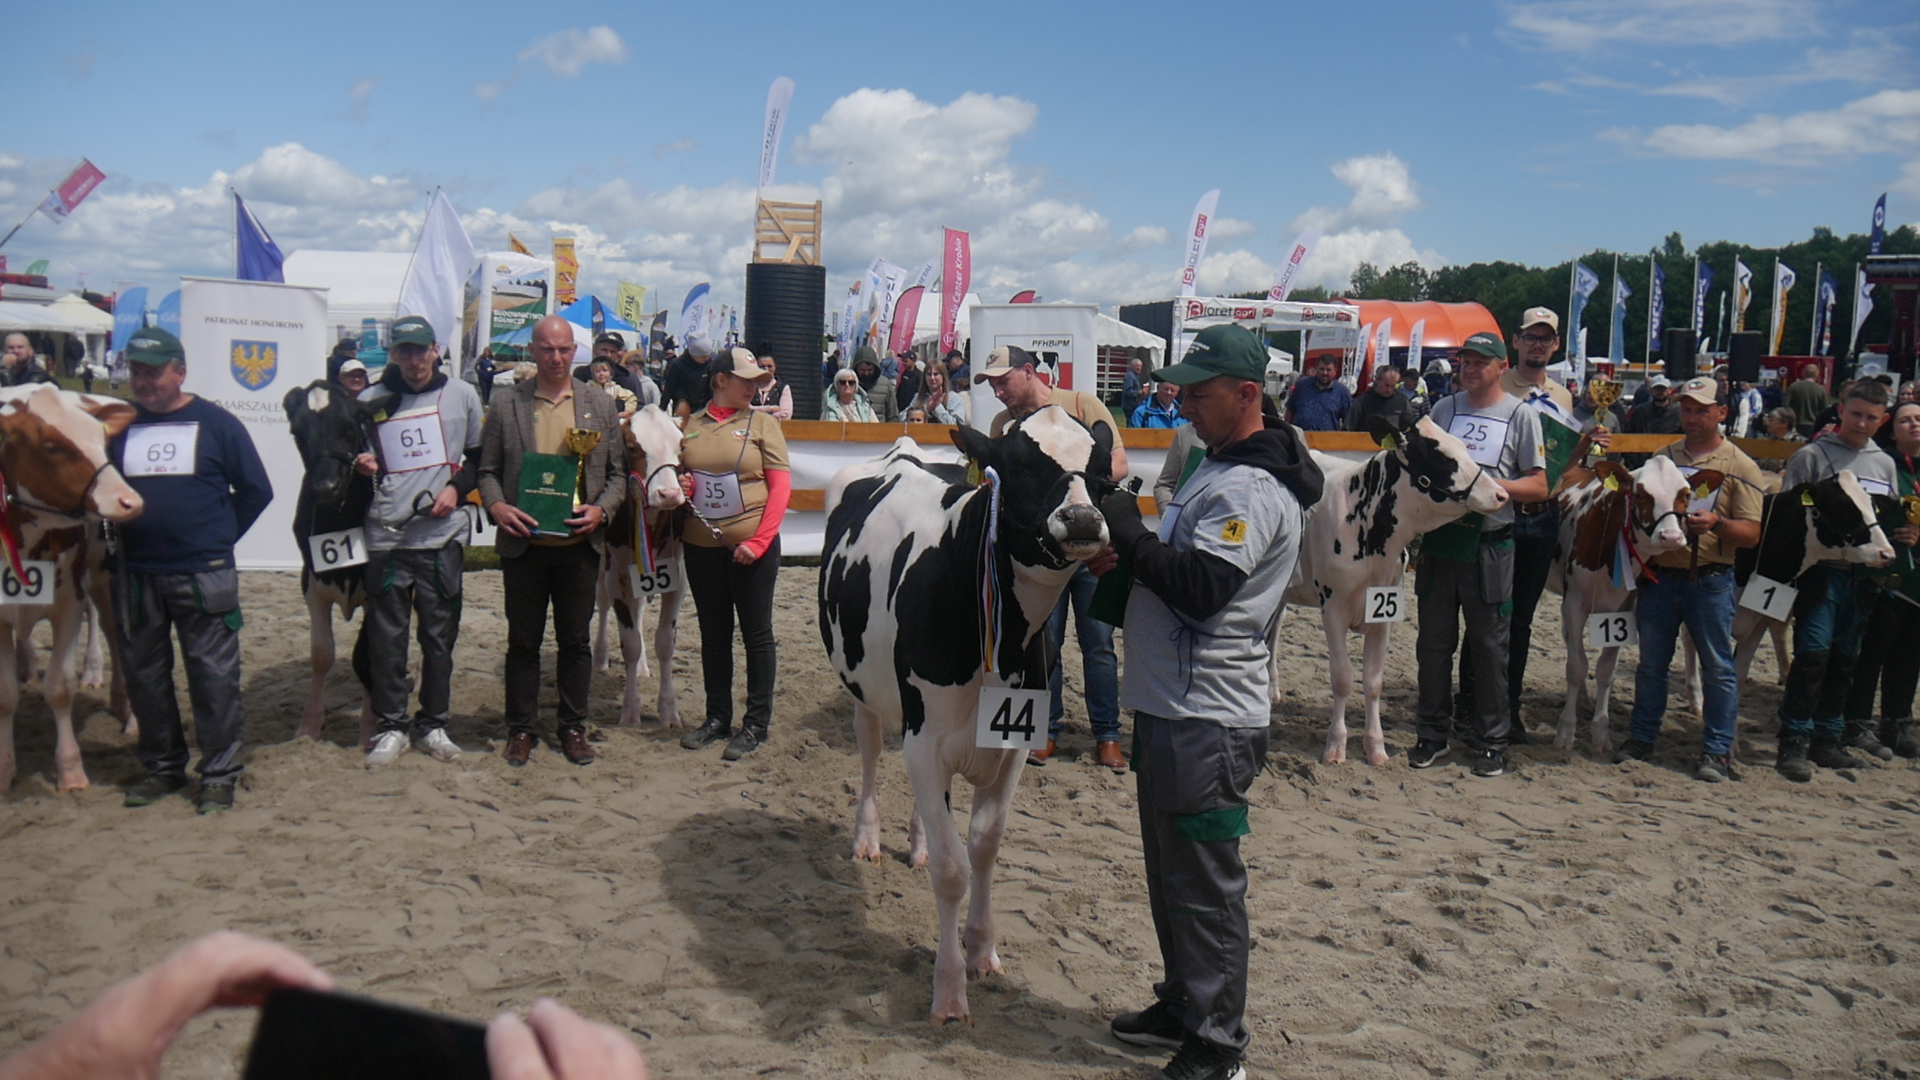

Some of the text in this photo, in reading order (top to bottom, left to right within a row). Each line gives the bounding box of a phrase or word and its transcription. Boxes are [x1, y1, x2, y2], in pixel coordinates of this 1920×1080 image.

[955, 237, 963, 270] Krobia
[953, 271, 963, 303] Center
[160, 312, 181, 322] GE
[204, 316, 305, 329] PATRONAT HONOROWY
[215, 399, 285, 413] MARSZAŁE
[400, 427, 428, 448] 61
[1462, 422, 1488, 441] 25
[147, 443, 177, 462] 69
[705, 481, 725, 499] 55
[320, 534, 355, 564] 61
[2, 566, 43, 597] 69
[640, 565, 671, 592] 55
[1372, 592, 1398, 618] 25
[1762, 586, 1778, 610] 1
[1598, 617, 1629, 643] 13
[989, 697, 1036, 742] 44
